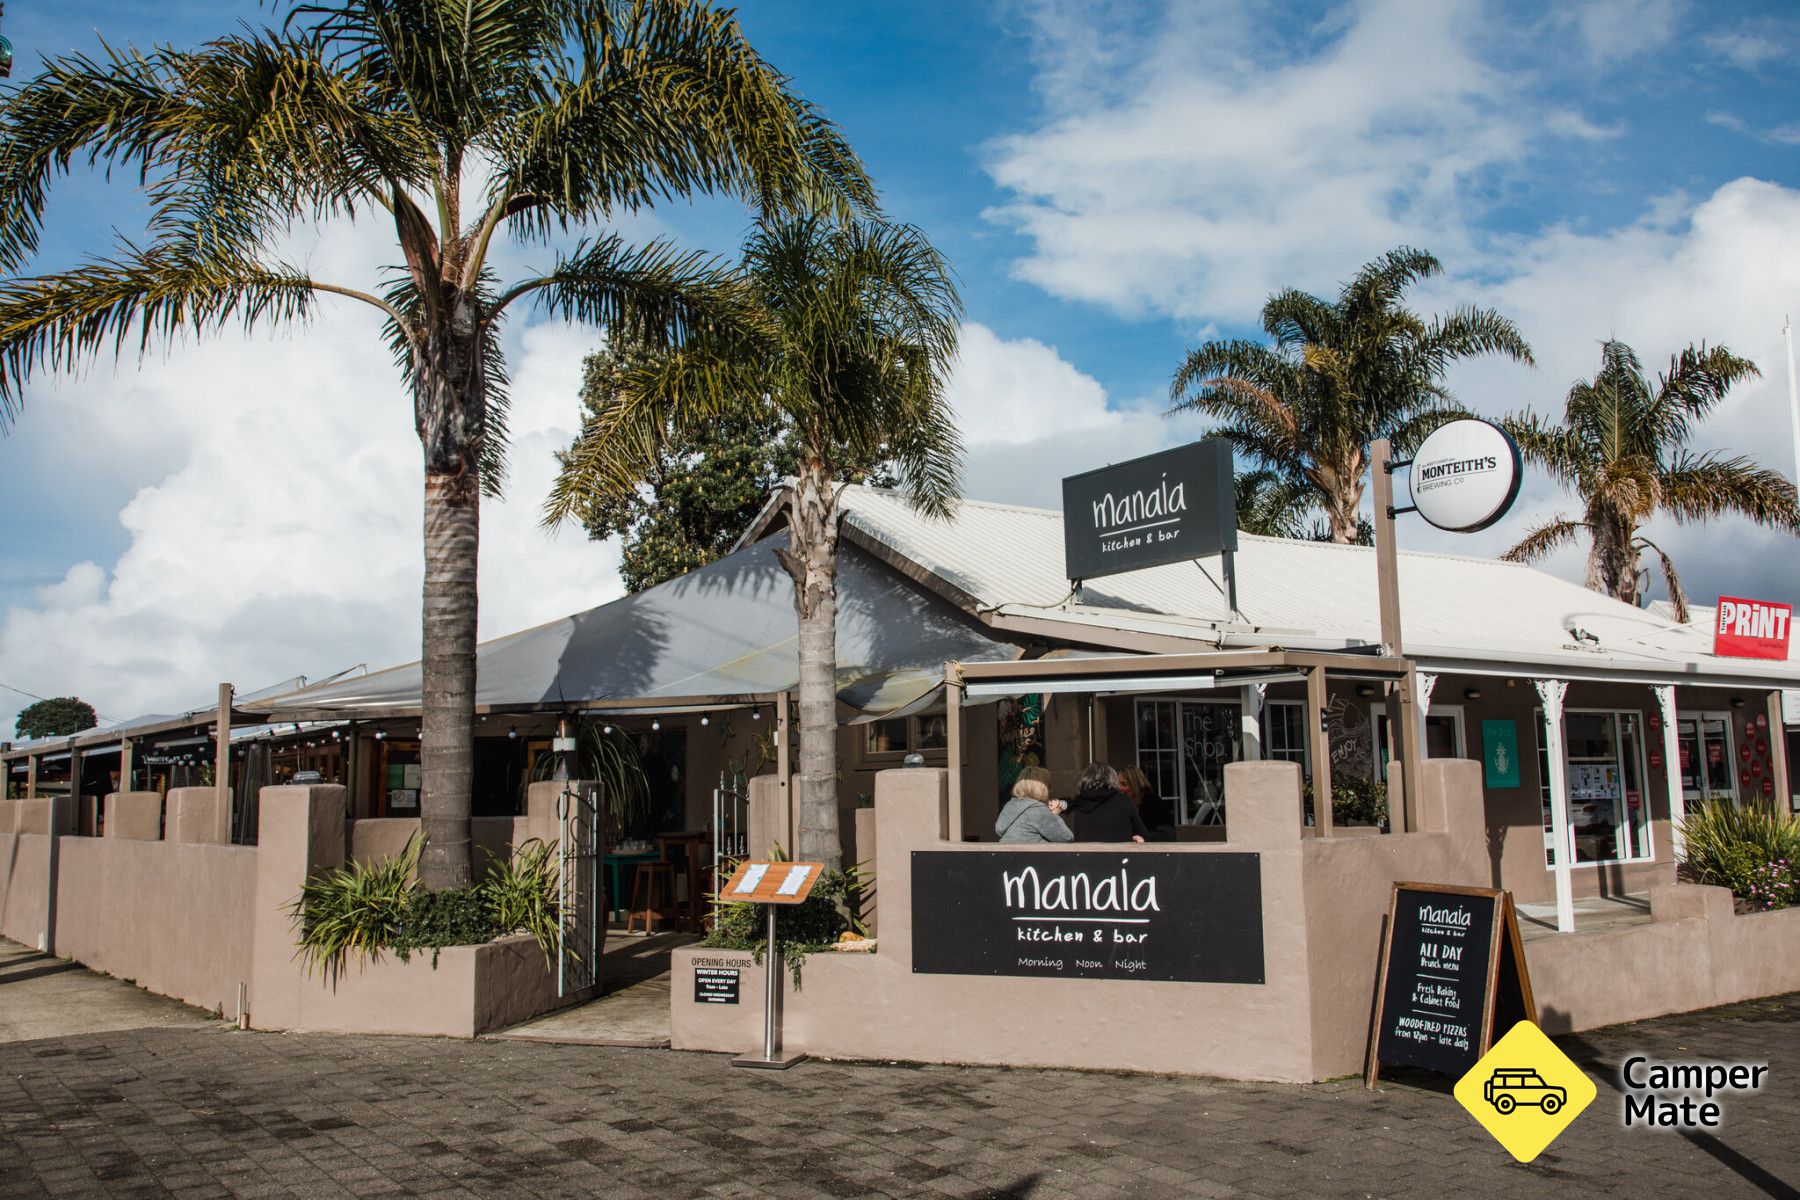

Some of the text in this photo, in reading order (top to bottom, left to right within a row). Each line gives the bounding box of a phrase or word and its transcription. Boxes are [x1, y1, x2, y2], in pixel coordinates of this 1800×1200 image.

[1421, 456, 1497, 481] MONTEITH'S
[1422, 479, 1453, 493] BREWING
[1093, 473, 1187, 528] manaia
[1102, 529, 1180, 553] kitchen & bar
[1183, 708, 1214, 732] The
[1331, 738, 1357, 764] ENJOY
[1003, 857, 1161, 912] manaia
[1419, 904, 1471, 926] manaia
[1017, 926, 1148, 944] kitchen & bar
[1421, 927, 1444, 935] kitchen
[1452, 929, 1466, 938] bar
[691, 957, 752, 968] OPENING HOURS
[1441, 944, 1463, 961] DAY
[1018, 957, 1147, 972] Morning Noon Night
[1420, 956, 1460, 971] Brunch menu
[1417, 982, 1457, 1001] Fresh Baking
[1420, 993, 1443, 1007] Cabinet
[1444, 997, 1460, 1010] Food
[1399, 1016, 1467, 1038] WOODFIRED PIZZAS
[1394, 1025, 1411, 1039] from
[1413, 1030, 1428, 1044] 12pm
[1438, 1033, 1453, 1046] late
[1453, 1036, 1470, 1052] daily
